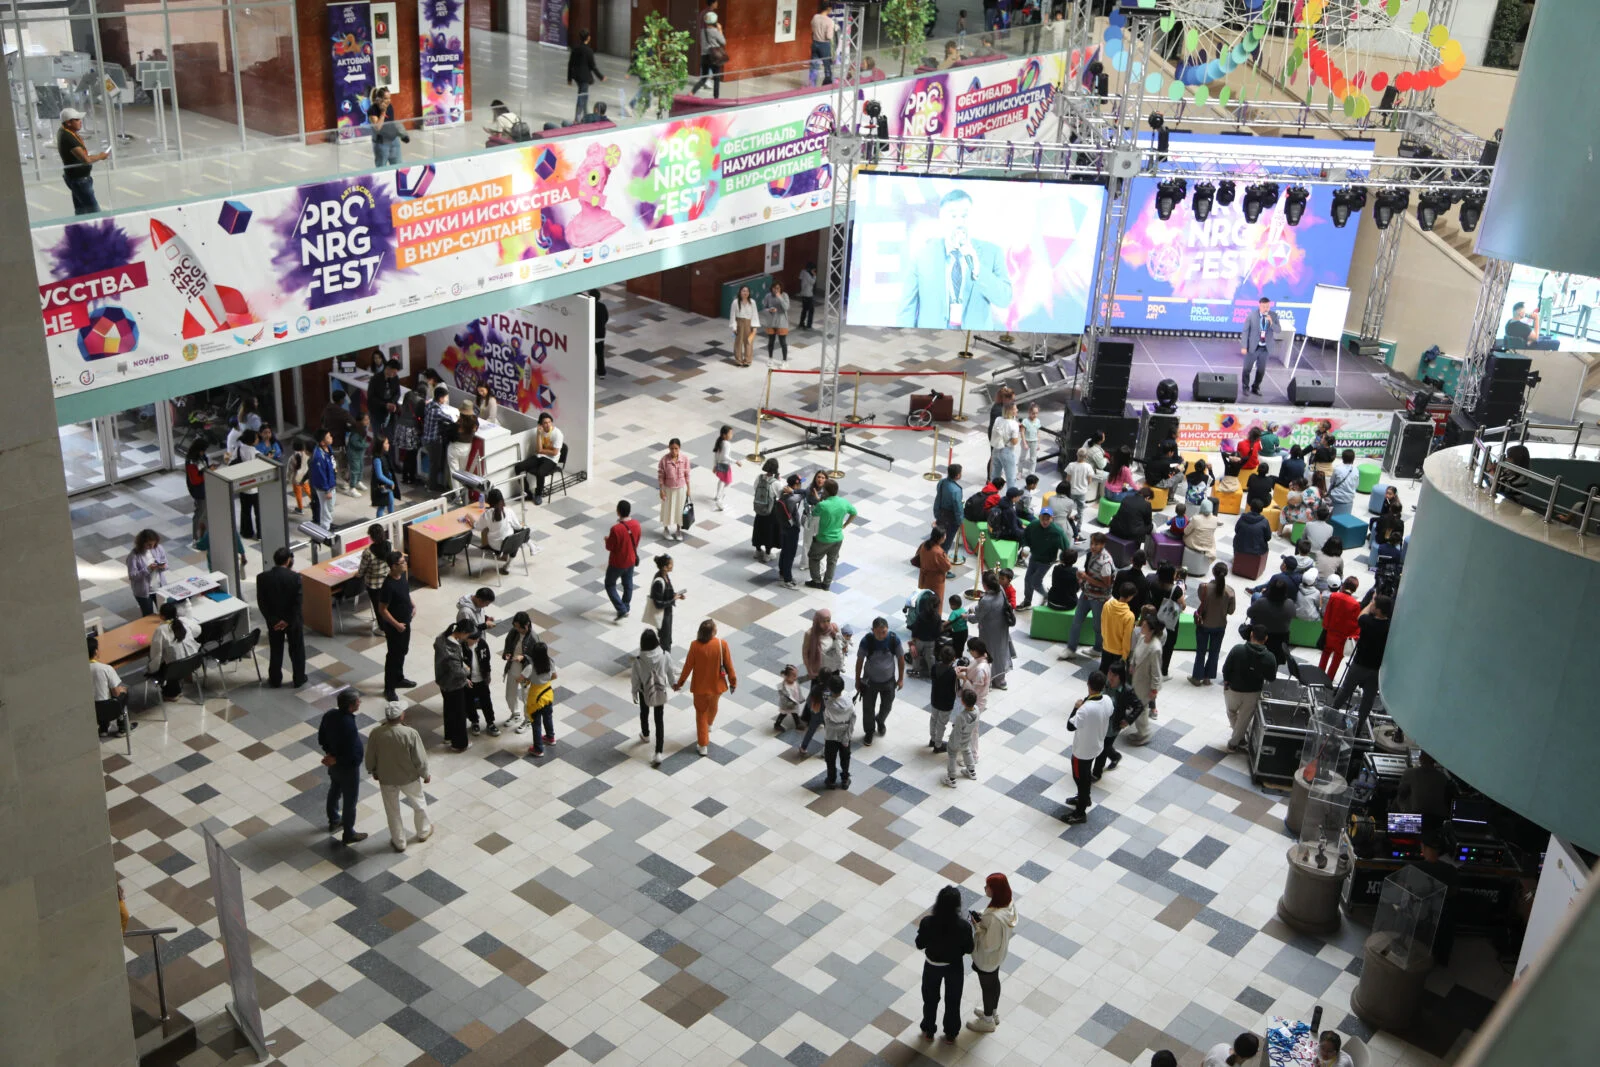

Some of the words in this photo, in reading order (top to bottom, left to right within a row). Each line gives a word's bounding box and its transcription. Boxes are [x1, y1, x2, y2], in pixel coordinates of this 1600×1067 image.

[337, 55, 371, 66] АКТОВЫЙ
[347, 65, 362, 73] ЗАЛ
[427, 54, 460, 63] ГАЛЕРЕЯ
[957, 105, 988, 124] НАУКИ
[988, 103, 996, 116] И
[996, 88, 1046, 113] ИСКУССТВА
[958, 83, 1012, 108] ФЕСТИВАЛЬ
[904, 111, 938, 136] NRG
[958, 128, 965, 138] В
[965, 110, 1024, 137] НУР-СУЛТАНЕ
[723, 126, 797, 155] ФЕСТИВАЛЬ
[723, 153, 765, 174] НАУКИ
[766, 150, 776, 163] И
[726, 179, 734, 191] В
[736, 156, 815, 189] НУР-СУЛТАНЕ
[653, 159, 700, 192] NRG
[397, 183, 503, 220] ФЕСТИВАЛЬ
[399, 213, 459, 242] НАУКИ
[462, 210, 474, 226] И
[476, 186, 571, 222] ИСКУССТВА
[653, 185, 707, 219] FEST
[301, 226, 371, 266] NRG
[404, 247, 417, 263] В
[419, 217, 532, 260] НУР-СУЛТАНЕ
[176, 265, 202, 294] NRG
[307, 255, 380, 298] FEST
[1147, 304, 1167, 314] PRO.
[1190, 306, 1210, 316] PRO.
[1190, 315, 1229, 323] TECHNOLOGY
[133, 353, 170, 368] NOVAKID
[485, 357, 515, 378] NRG
[487, 374, 519, 393] FEST
